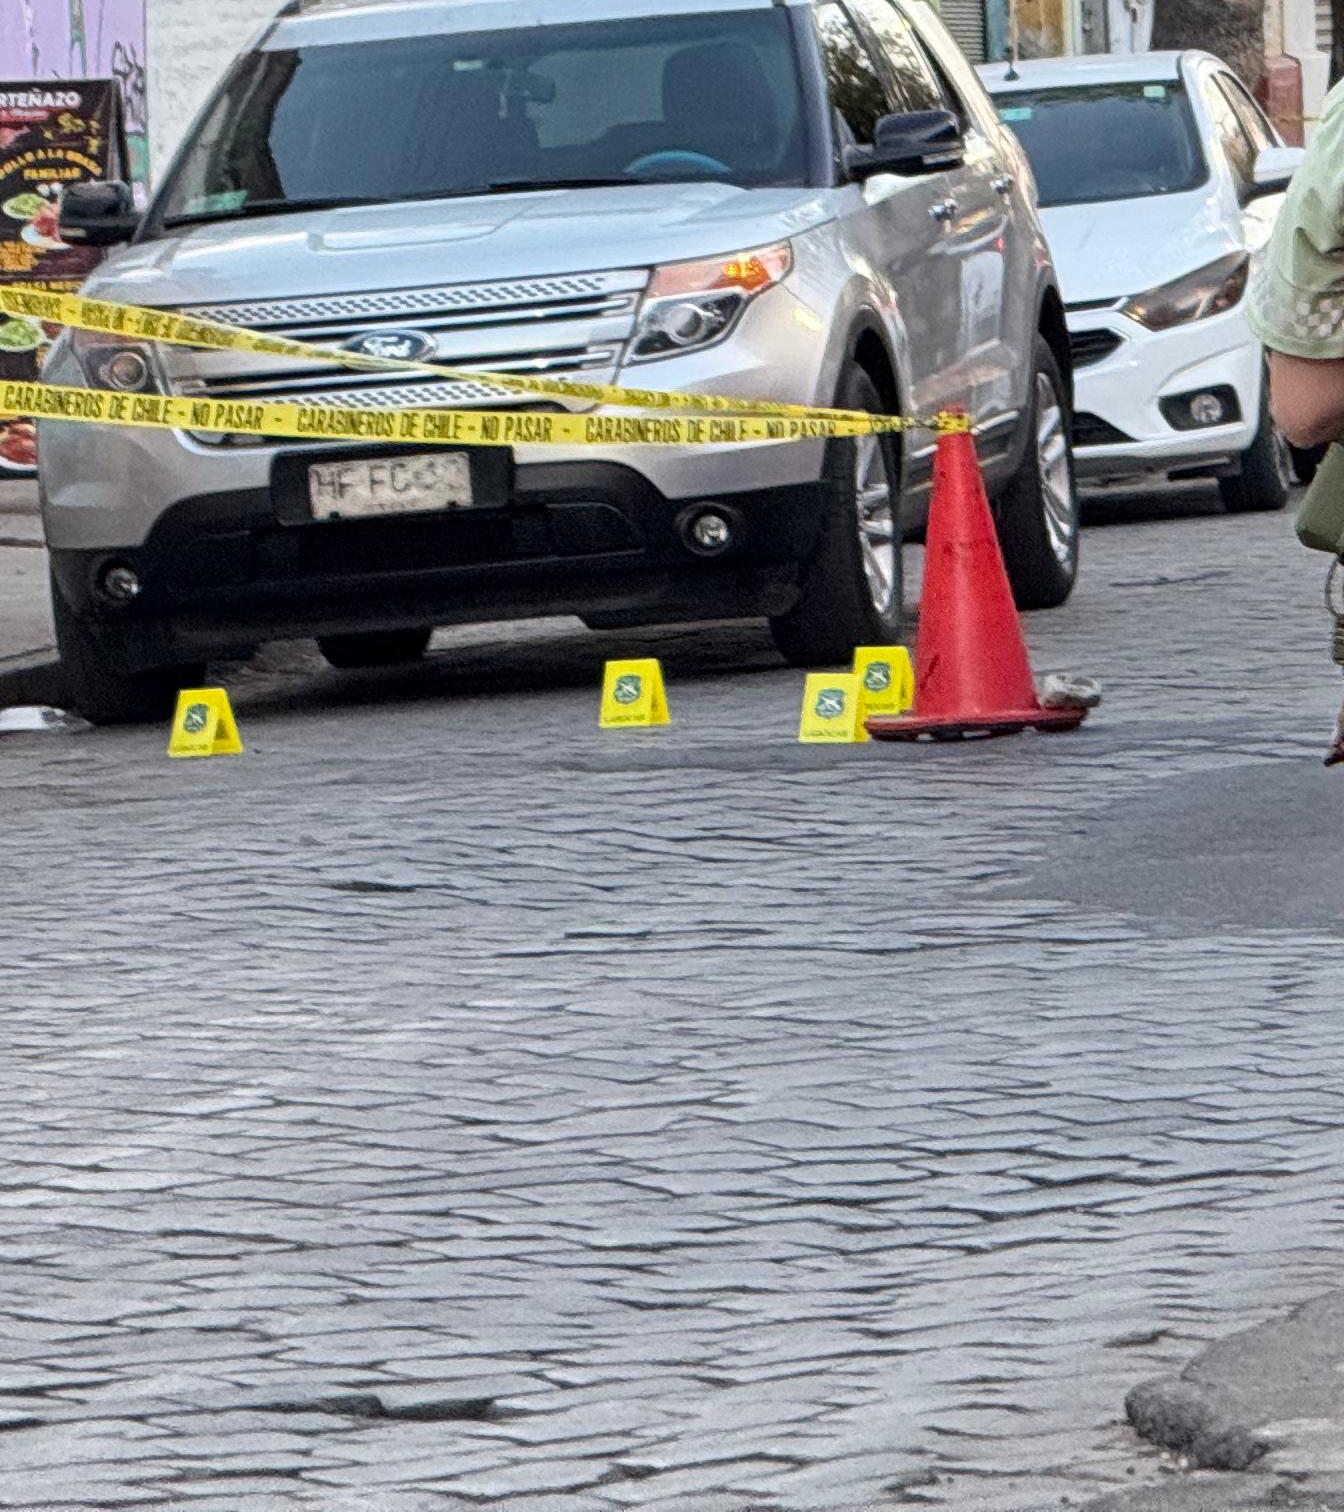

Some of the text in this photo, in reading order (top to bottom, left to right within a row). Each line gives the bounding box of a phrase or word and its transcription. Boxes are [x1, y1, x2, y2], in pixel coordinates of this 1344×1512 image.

[3, 385, 102, 419] CARABINEROS
[108, 396, 128, 421] DE
[131, 397, 172, 425] CHILE
[189, 402, 210, 427] NO
[213, 403, 264, 430] PASAR
[298, 408, 395, 436] CARABINEROS
[400, 412, 418, 437] DE
[423, 414, 463, 439] CHILE
[480, 416, 500, 440] NO
[504, 416, 552, 442] PASAR
[585, 417, 681, 443] CARABINEROS
[686, 419, 706, 442] DE
[709, 418, 748, 440] CHILE
[767, 419, 785, 439] NO
[789, 420, 836, 438] PASAR
